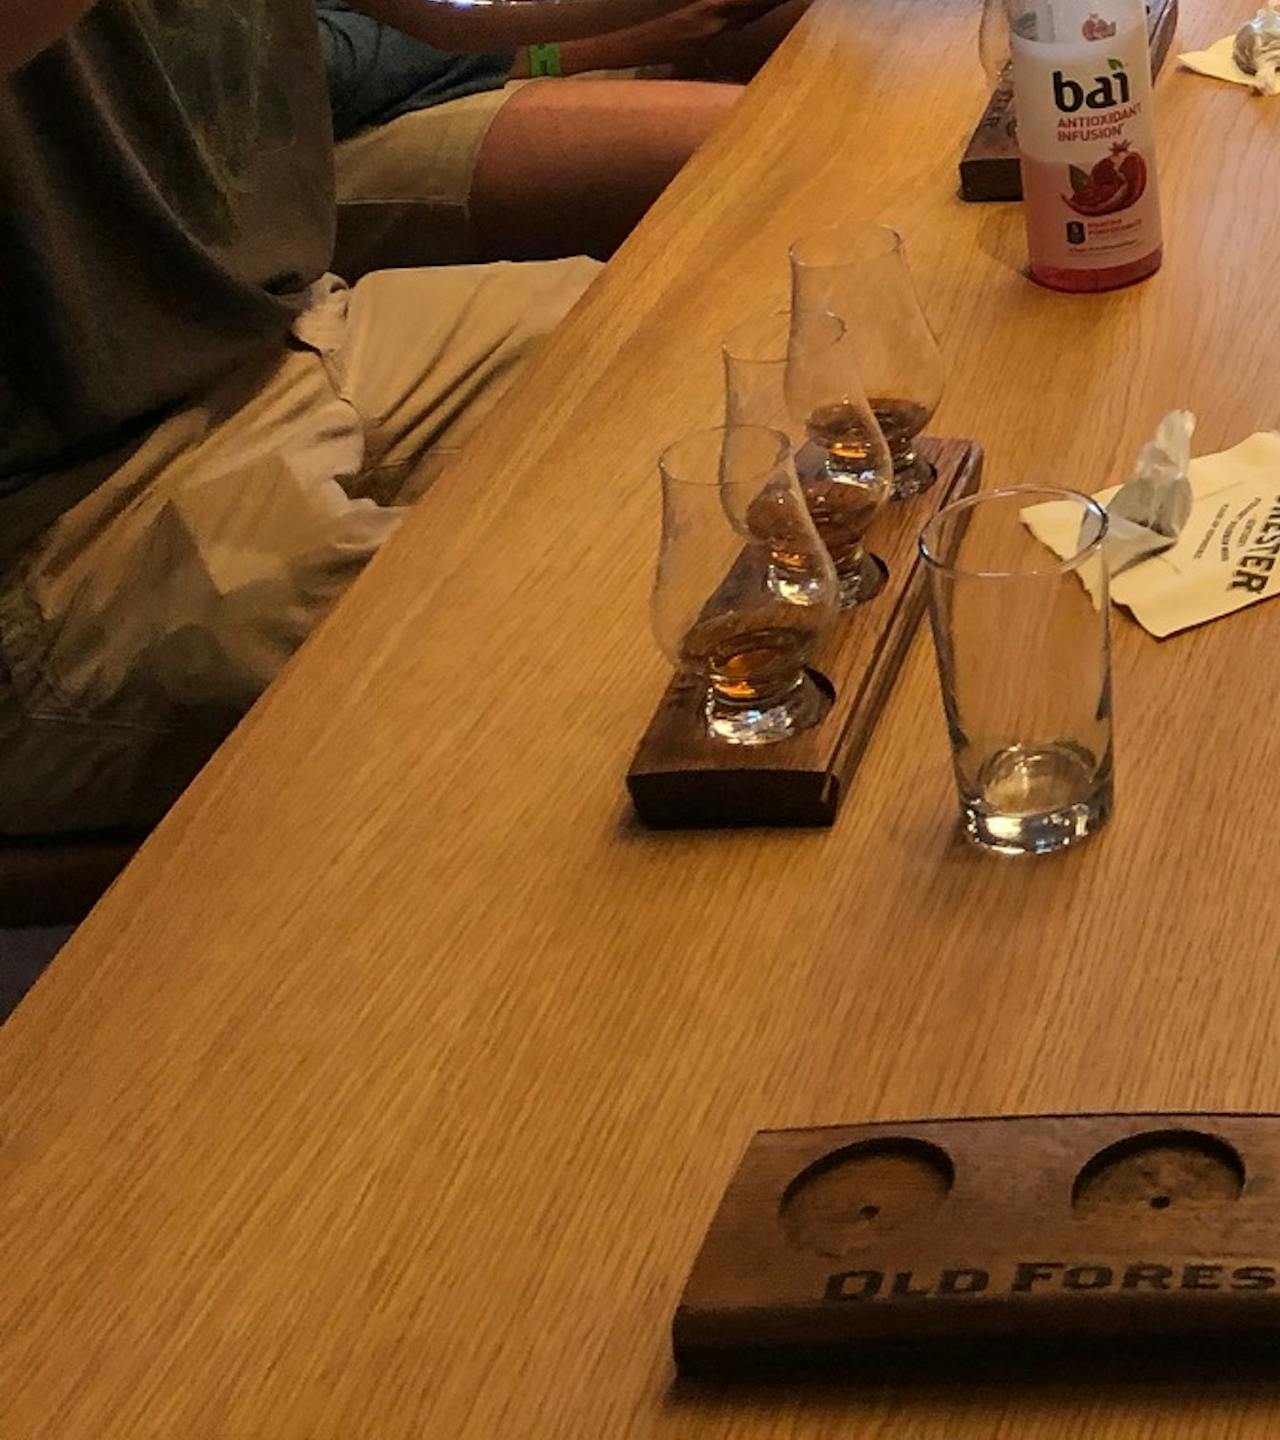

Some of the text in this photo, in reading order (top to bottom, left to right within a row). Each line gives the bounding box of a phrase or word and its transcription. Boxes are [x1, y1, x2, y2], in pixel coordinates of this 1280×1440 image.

[1053, 60, 1130, 113] bai
[1056, 103, 1142, 130] ANTIOXIDANT
[1056, 122, 1122, 142] INFUSION
[824, 1266, 990, 1304] OLD
